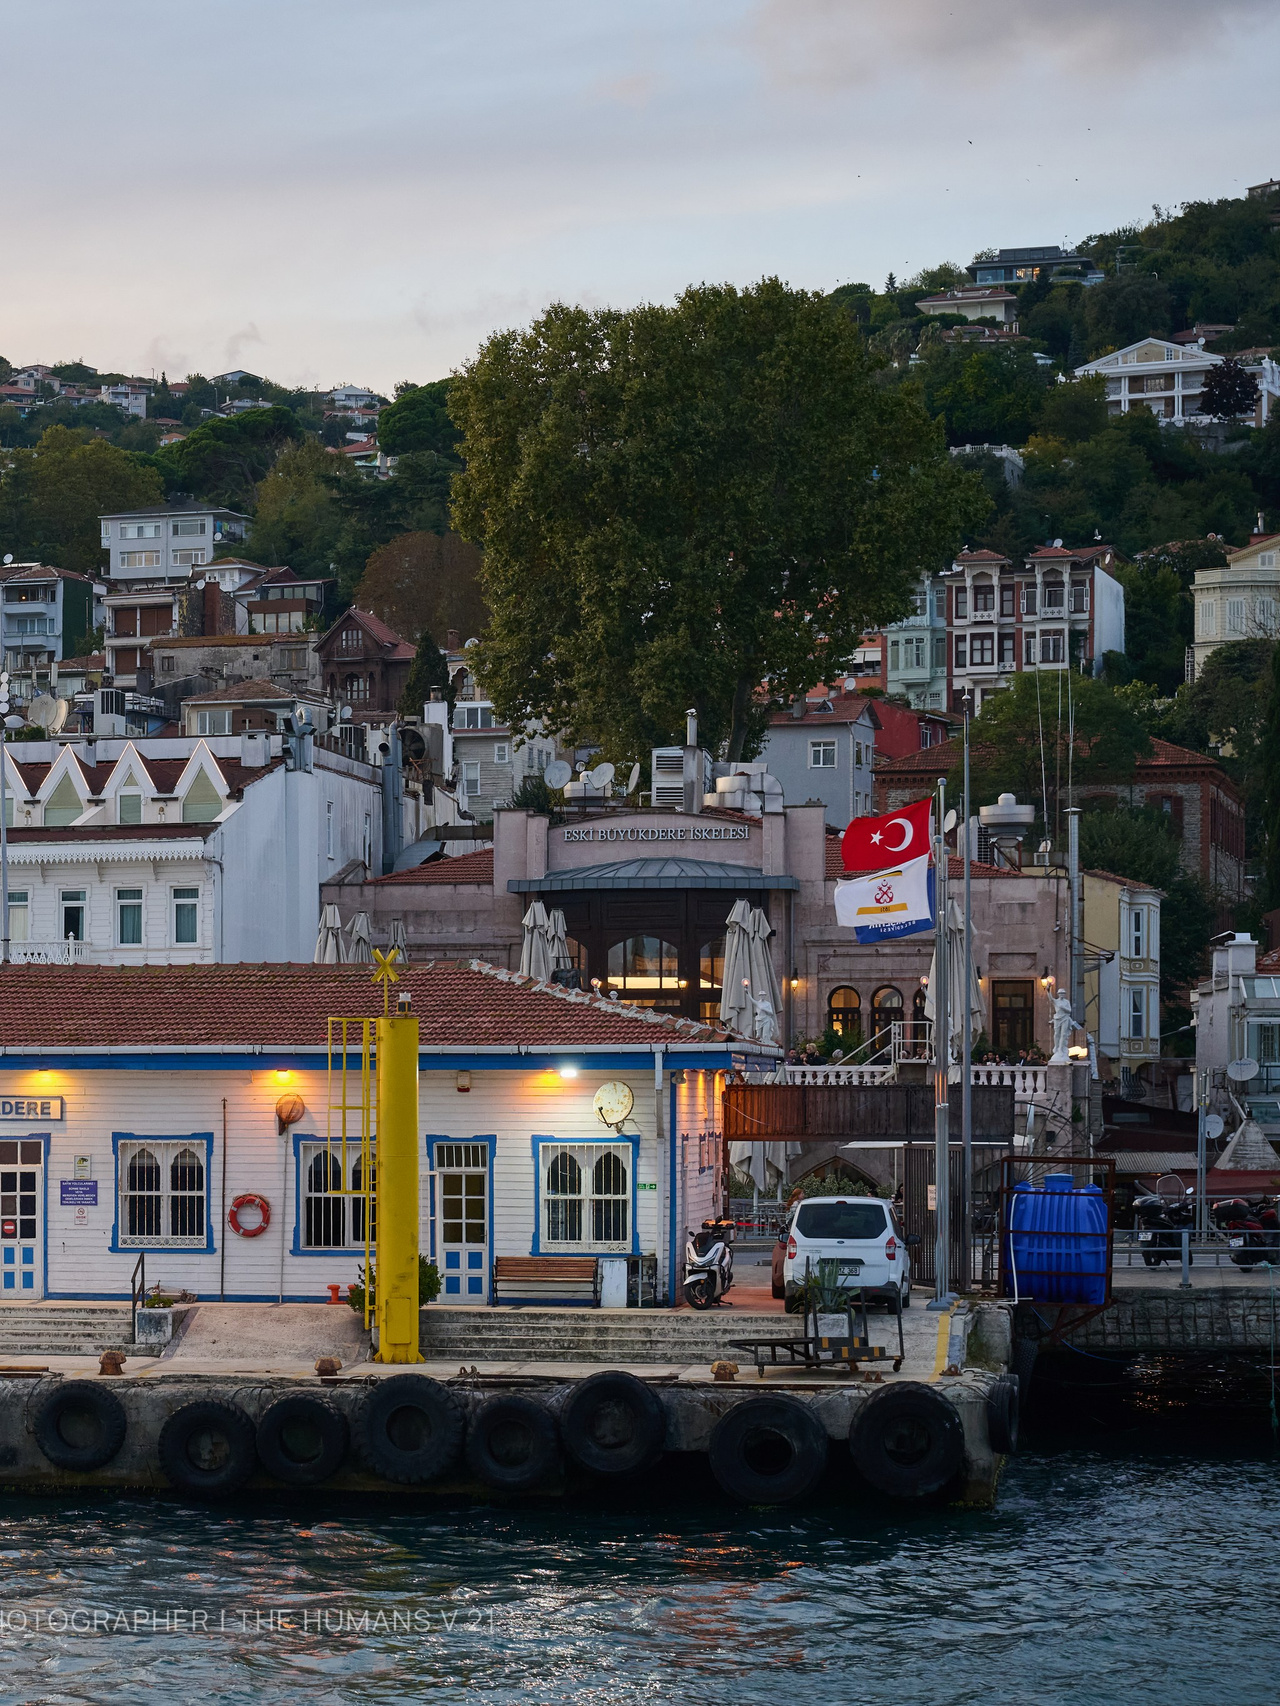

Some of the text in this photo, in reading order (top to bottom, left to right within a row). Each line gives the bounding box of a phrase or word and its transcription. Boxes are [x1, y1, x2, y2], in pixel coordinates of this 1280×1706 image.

[563, 825, 750, 842] ESKİ BÜYÜKDERE İSKELESİ
